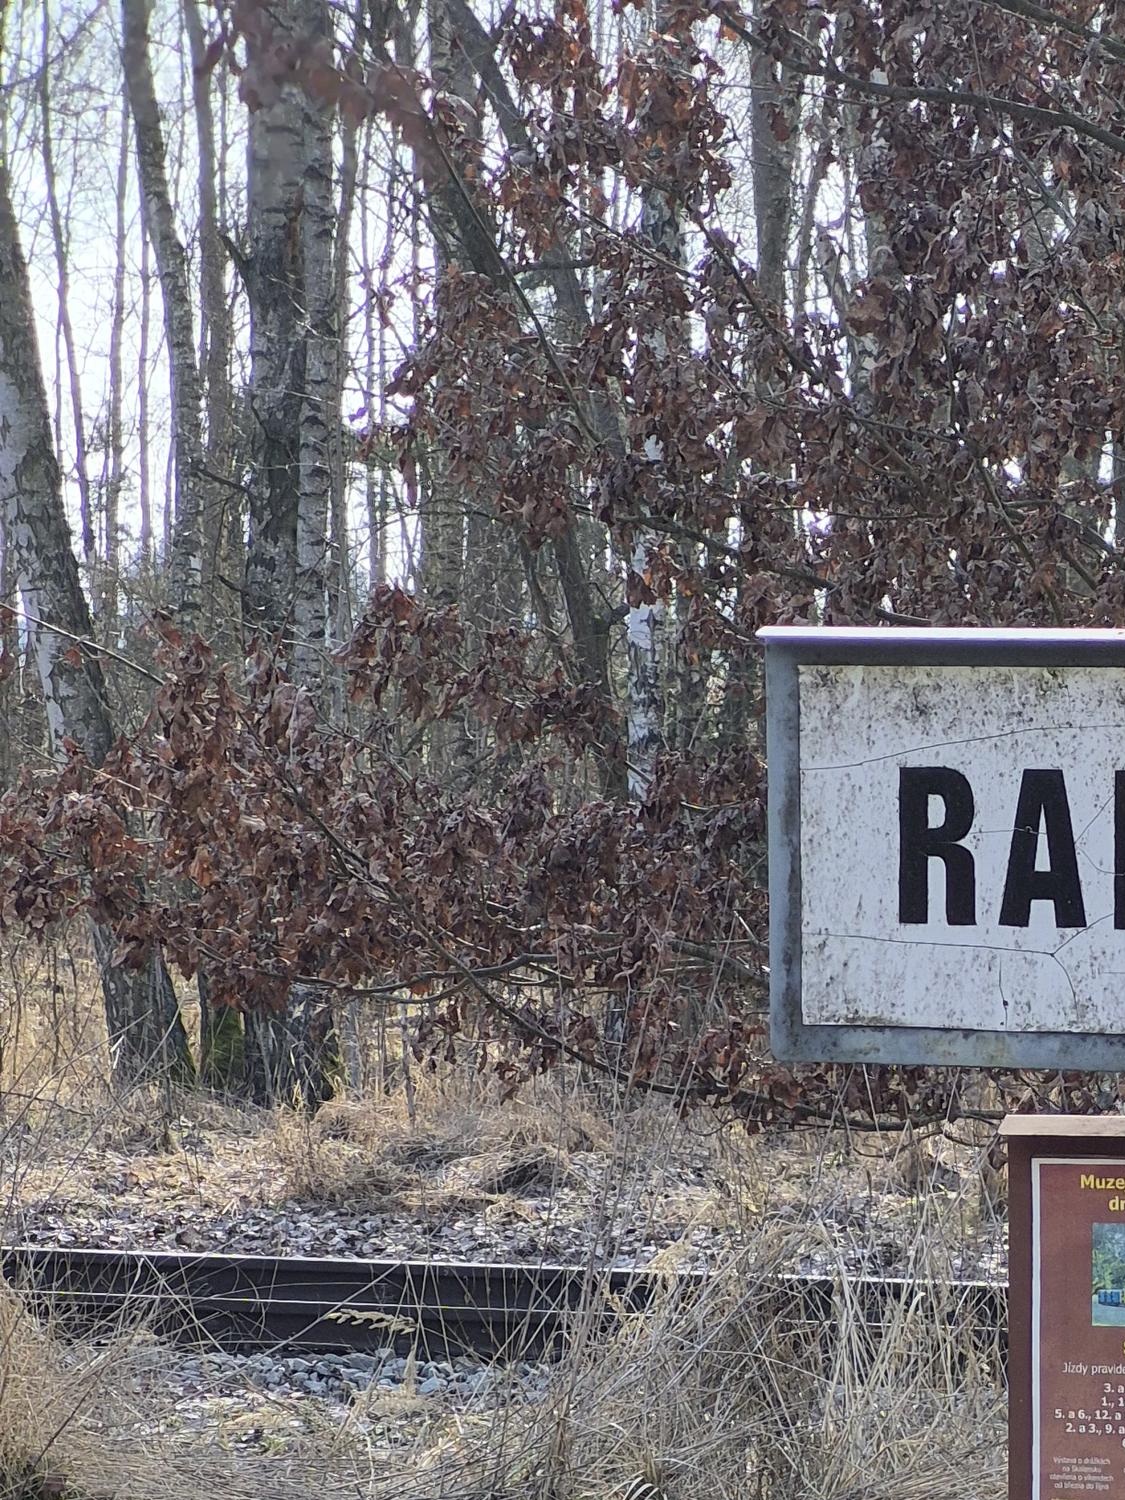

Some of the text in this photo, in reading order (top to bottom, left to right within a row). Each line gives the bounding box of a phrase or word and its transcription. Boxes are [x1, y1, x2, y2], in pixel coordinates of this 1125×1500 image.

[1062, 1362, 1088, 1376] Jízdy
[1104, 1383, 1114, 1393] 3.
[1117, 1385, 1125, 1393] a
[1101, 1396, 1114, 1409] 1.,
[1054, 1409, 1065, 1419] 5.
[1068, 1411, 1075, 1419] a
[1077, 1410, 1092, 1421] 6.,
[1095, 1410, 1112, 1420] 12.
[1114, 1412, 1121, 1420] a
[1066, 1423, 1076, 1432] 2.
[1079, 1425, 1086, 1433] a
[1088, 1424, 1102, 1435] 3.,
[1105, 1424, 1115, 1434] 9.
[1118, 1426, 1125, 1434] a
